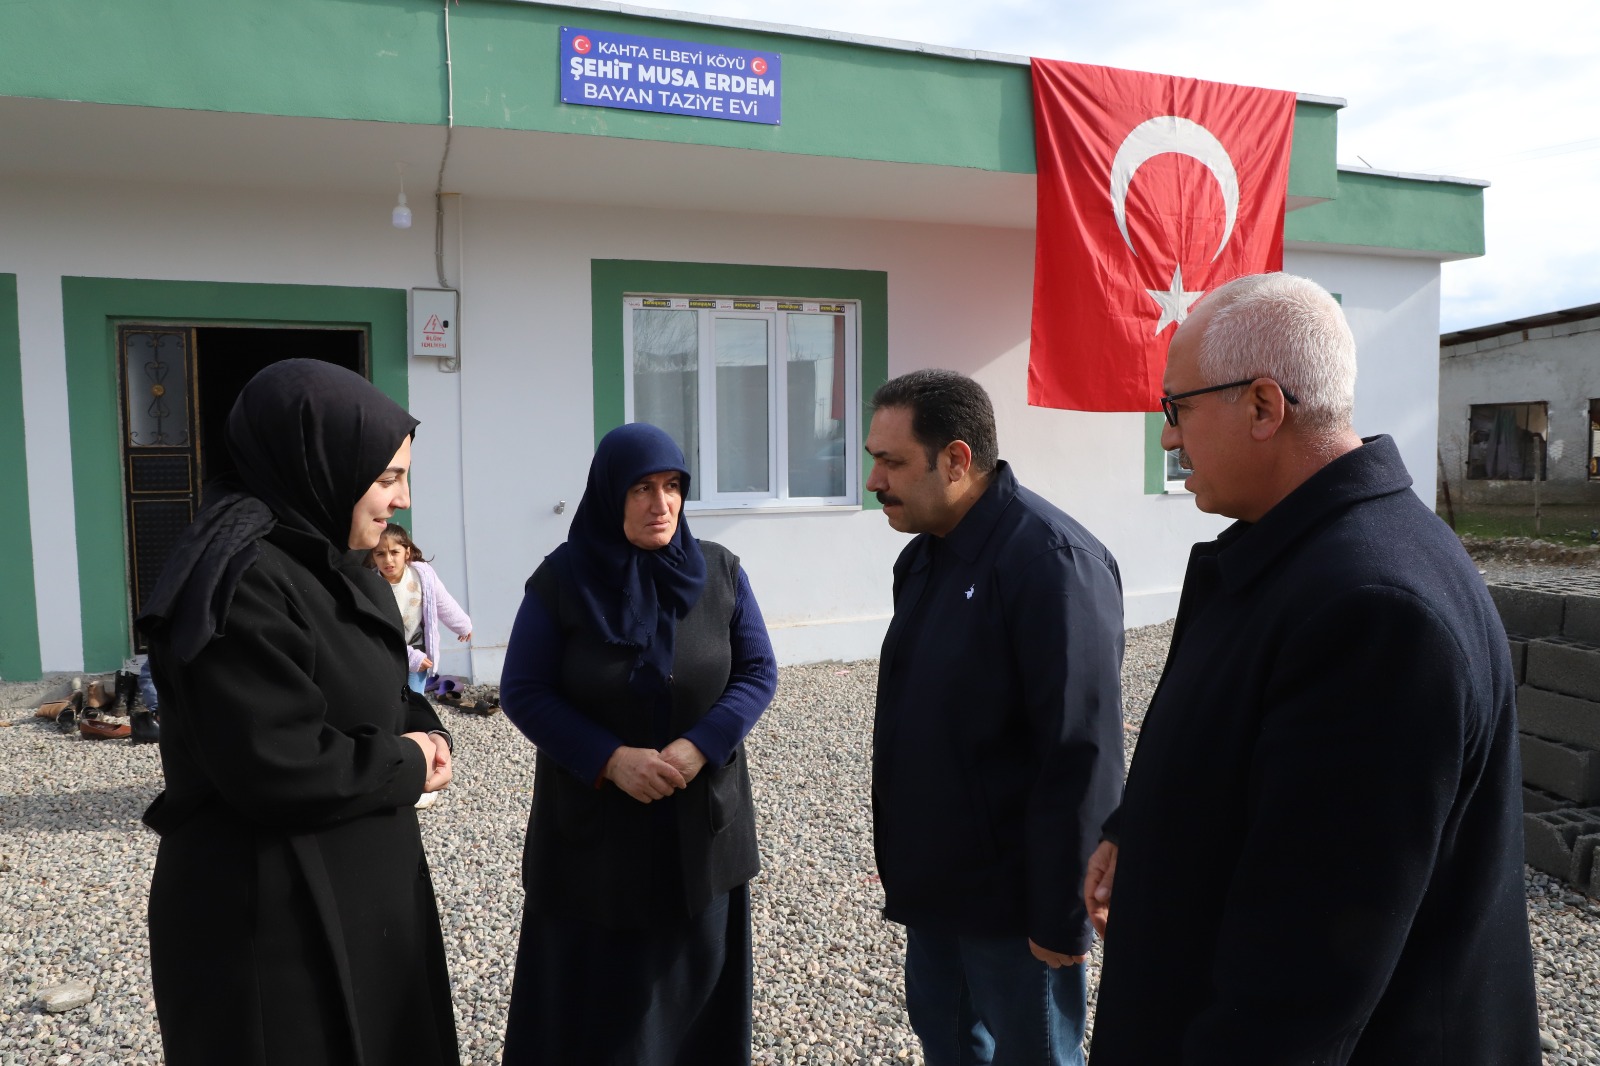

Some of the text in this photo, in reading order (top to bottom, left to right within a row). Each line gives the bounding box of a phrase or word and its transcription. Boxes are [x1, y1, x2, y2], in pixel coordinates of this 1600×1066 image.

[598, 41, 746, 70] KAHTA ELBEYİ KÖYÜ
[570, 57, 775, 97] ŞEHİT MUSA ERDEM
[584, 83, 758, 116] BAYAN TAZİYE EVİ
